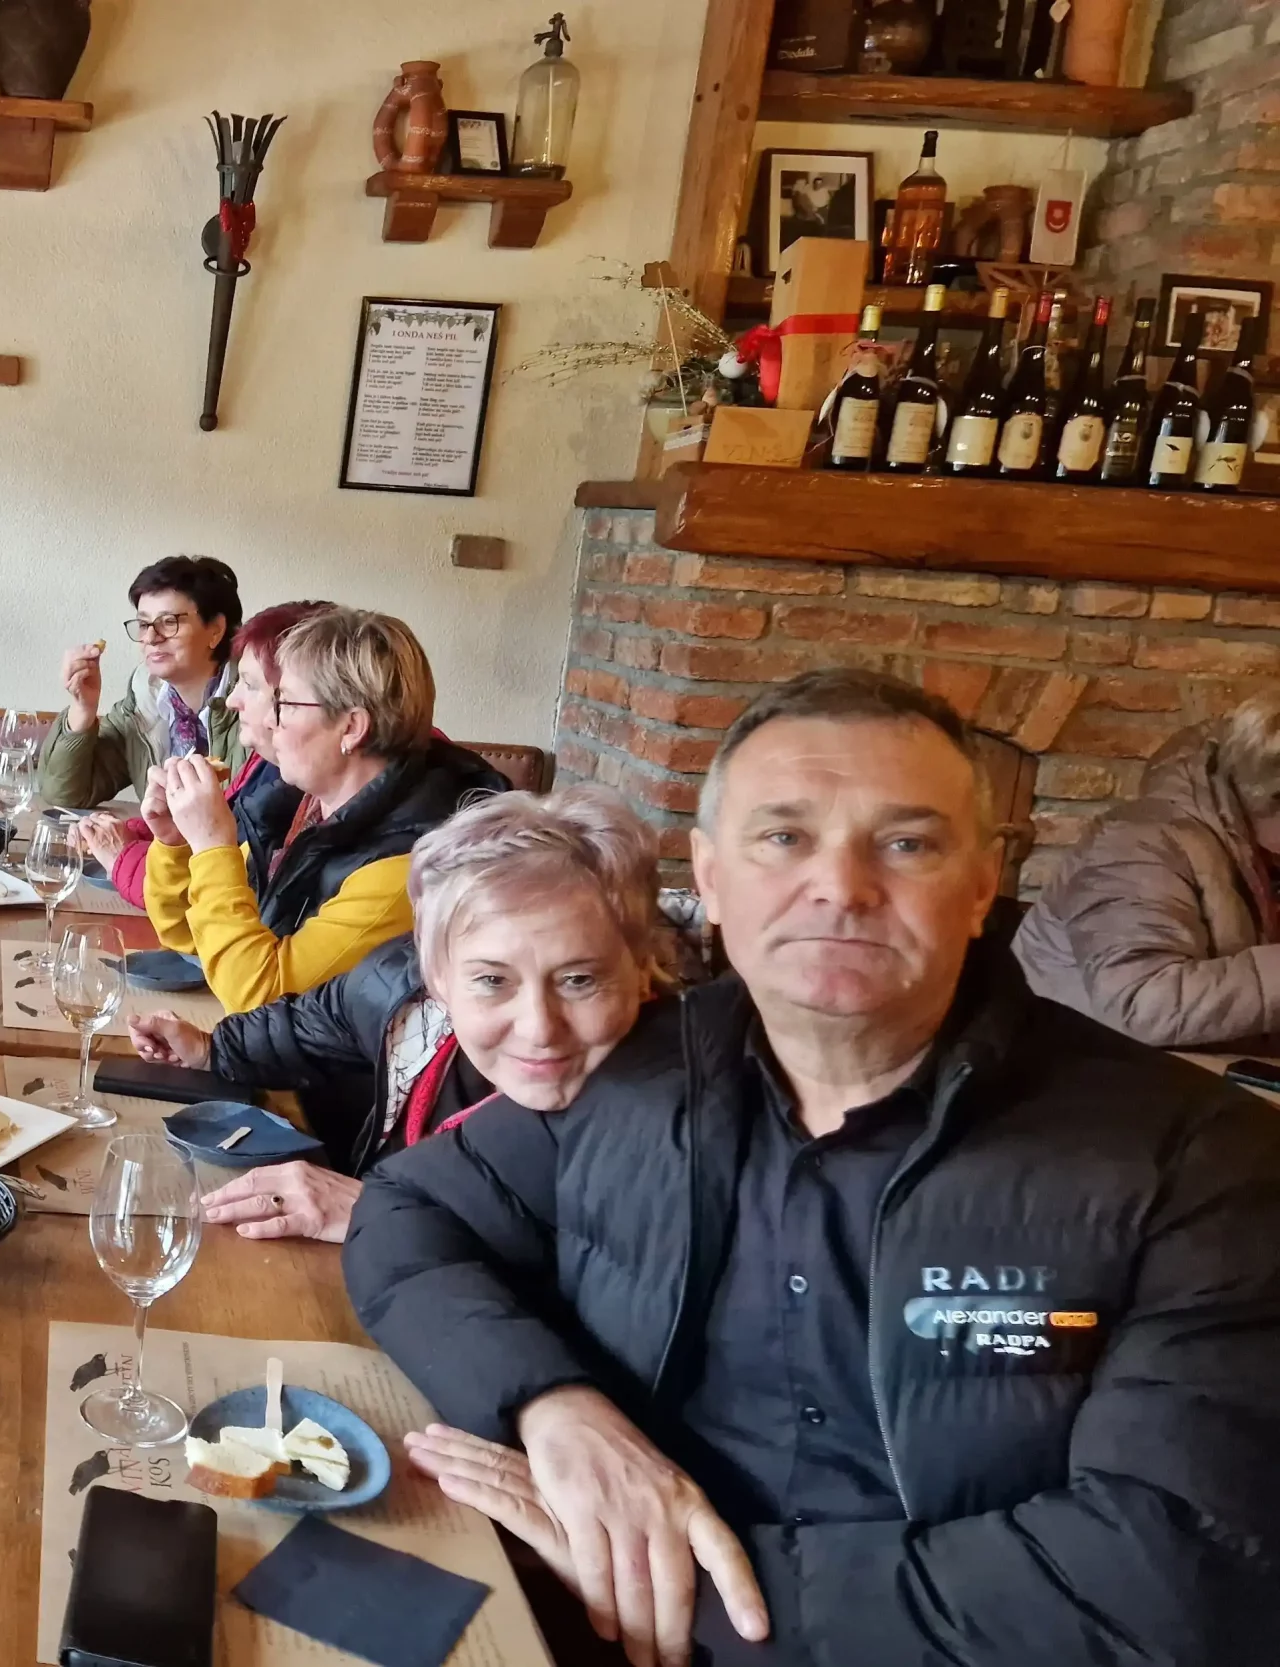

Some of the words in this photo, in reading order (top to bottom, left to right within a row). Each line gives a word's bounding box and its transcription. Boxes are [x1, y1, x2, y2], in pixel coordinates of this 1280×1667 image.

[397, 330, 424, 339] ONDA
[933, 1310, 1048, 1326] Alexander
[975, 1334, 1051, 1348] RADPA
